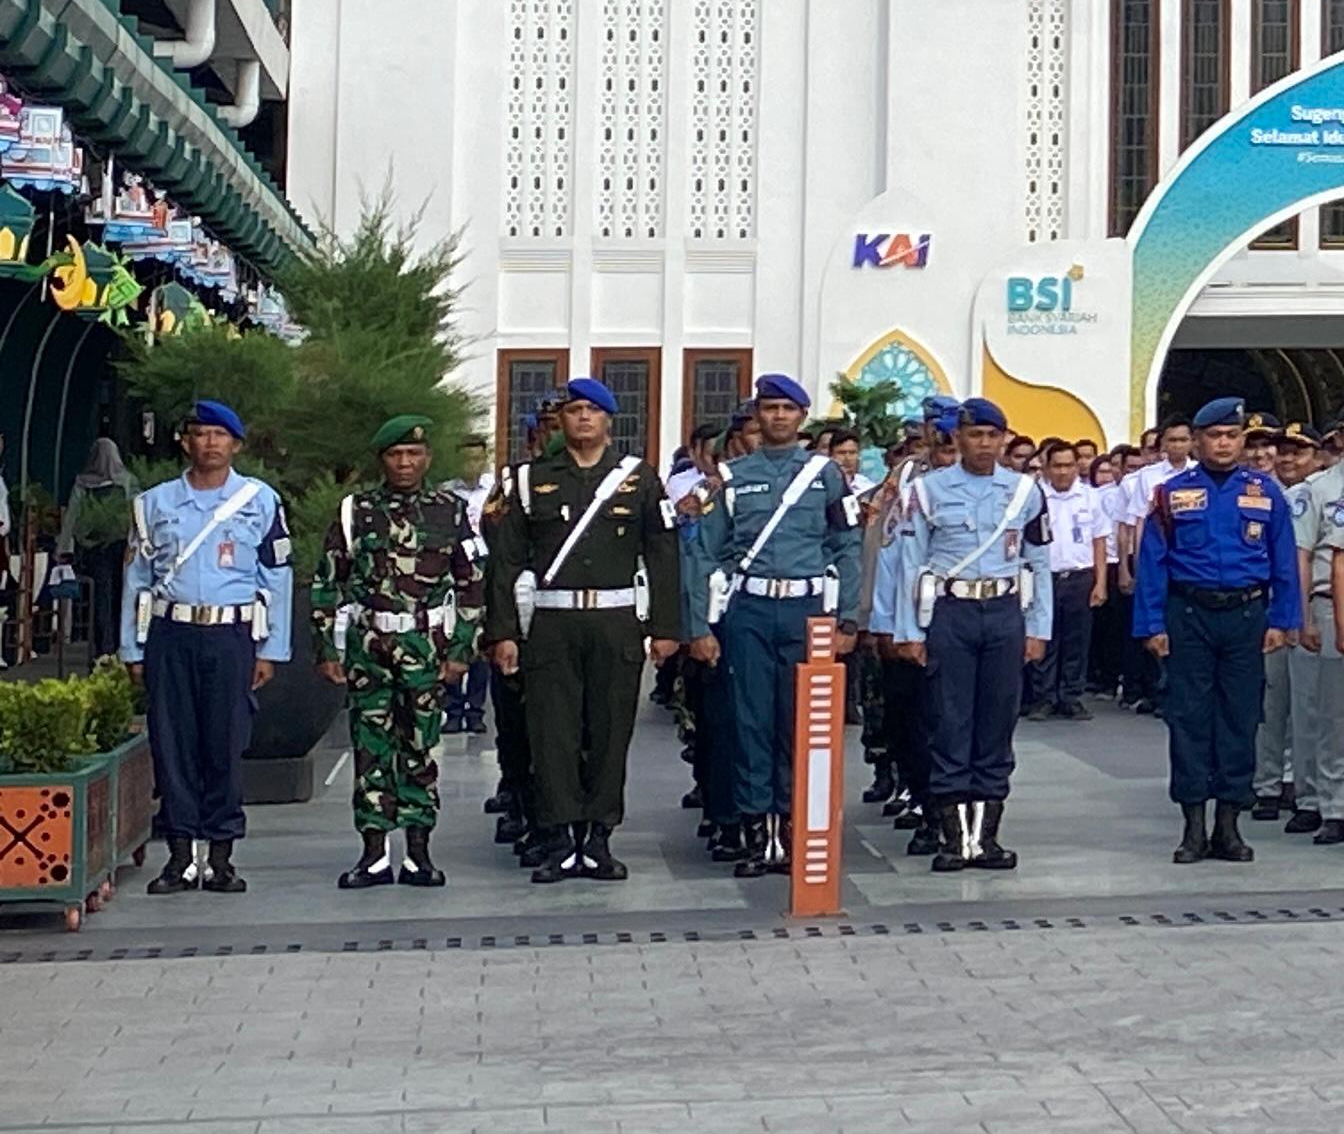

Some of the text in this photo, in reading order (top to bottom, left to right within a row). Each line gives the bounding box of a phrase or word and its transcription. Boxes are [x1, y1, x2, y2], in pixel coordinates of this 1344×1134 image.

[1250, 128, 1320, 145] Selamat
[852, 233, 932, 269] KAI
[1006, 276, 1073, 312] BSI
